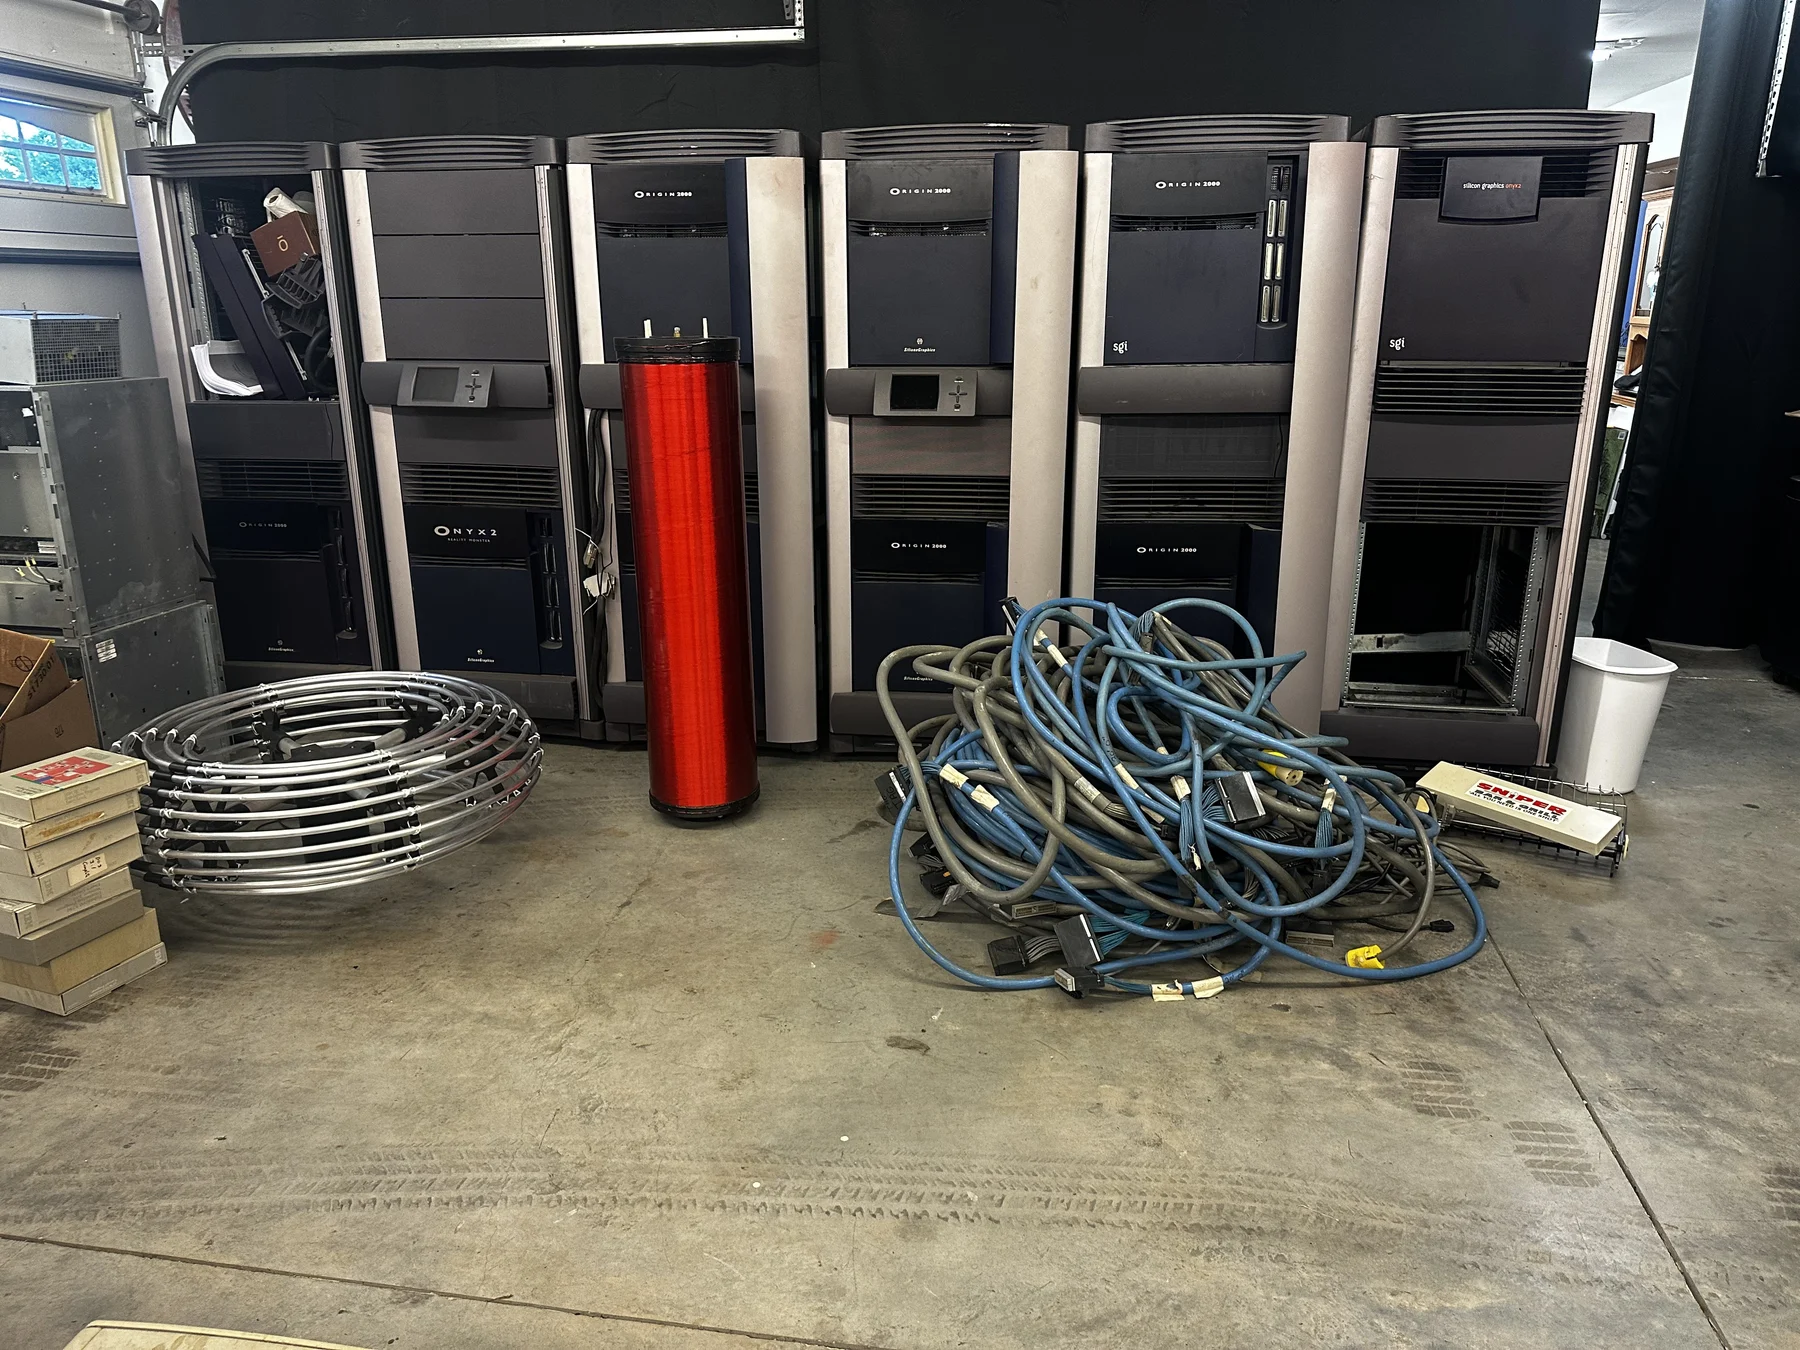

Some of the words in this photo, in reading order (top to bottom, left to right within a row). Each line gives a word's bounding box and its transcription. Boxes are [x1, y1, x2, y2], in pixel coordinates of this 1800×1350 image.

[890, 187, 933, 196] ORIGIN
[1155, 181, 1201, 189] ORIGIN
[1481, 182, 1504, 190] graphics
[634, 190, 675, 198] ORIGIN
[1113, 340, 1128, 354] sgi
[1389, 337, 1405, 351] sgi
[1474, 789, 1503, 802] BAR
[1519, 803, 1559, 820] GRILL
[1483, 795, 1496, 803] YOU
[1497, 800, 1514, 808] NEED
[24, 911, 34, 929] IBM
